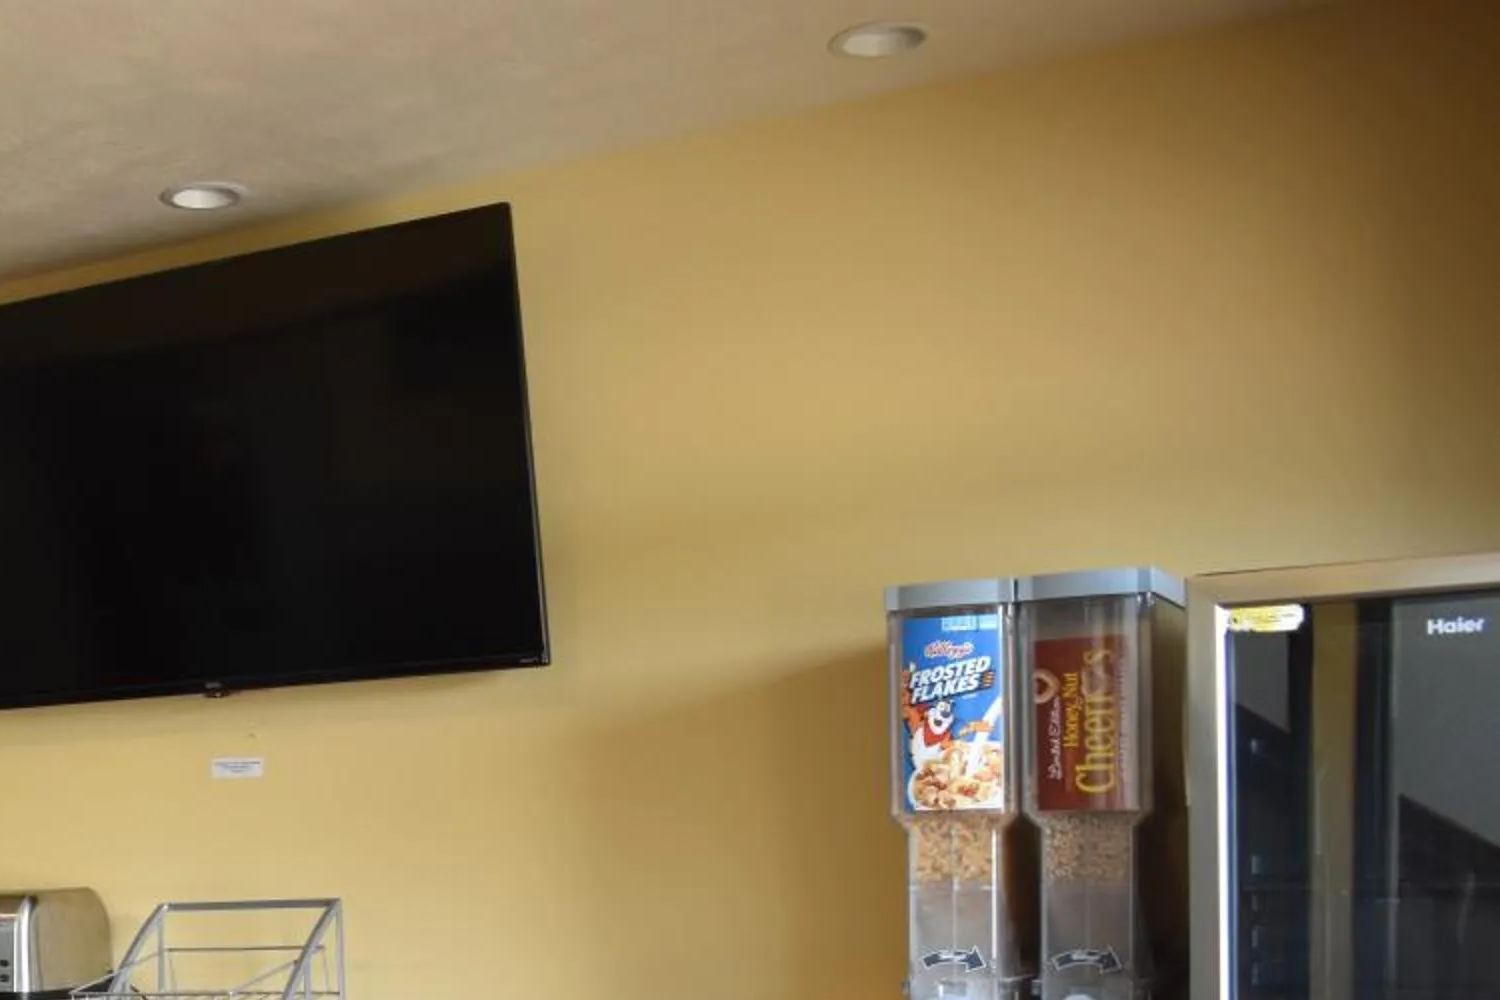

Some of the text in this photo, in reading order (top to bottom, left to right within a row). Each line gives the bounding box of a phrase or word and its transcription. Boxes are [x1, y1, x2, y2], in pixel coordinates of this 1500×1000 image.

[1427, 617, 1485, 635] Haier
[910, 656, 991, 688] FROSTED
[912, 674, 980, 704] FLAKES
[1063, 671, 1081, 748] Honey Nut
